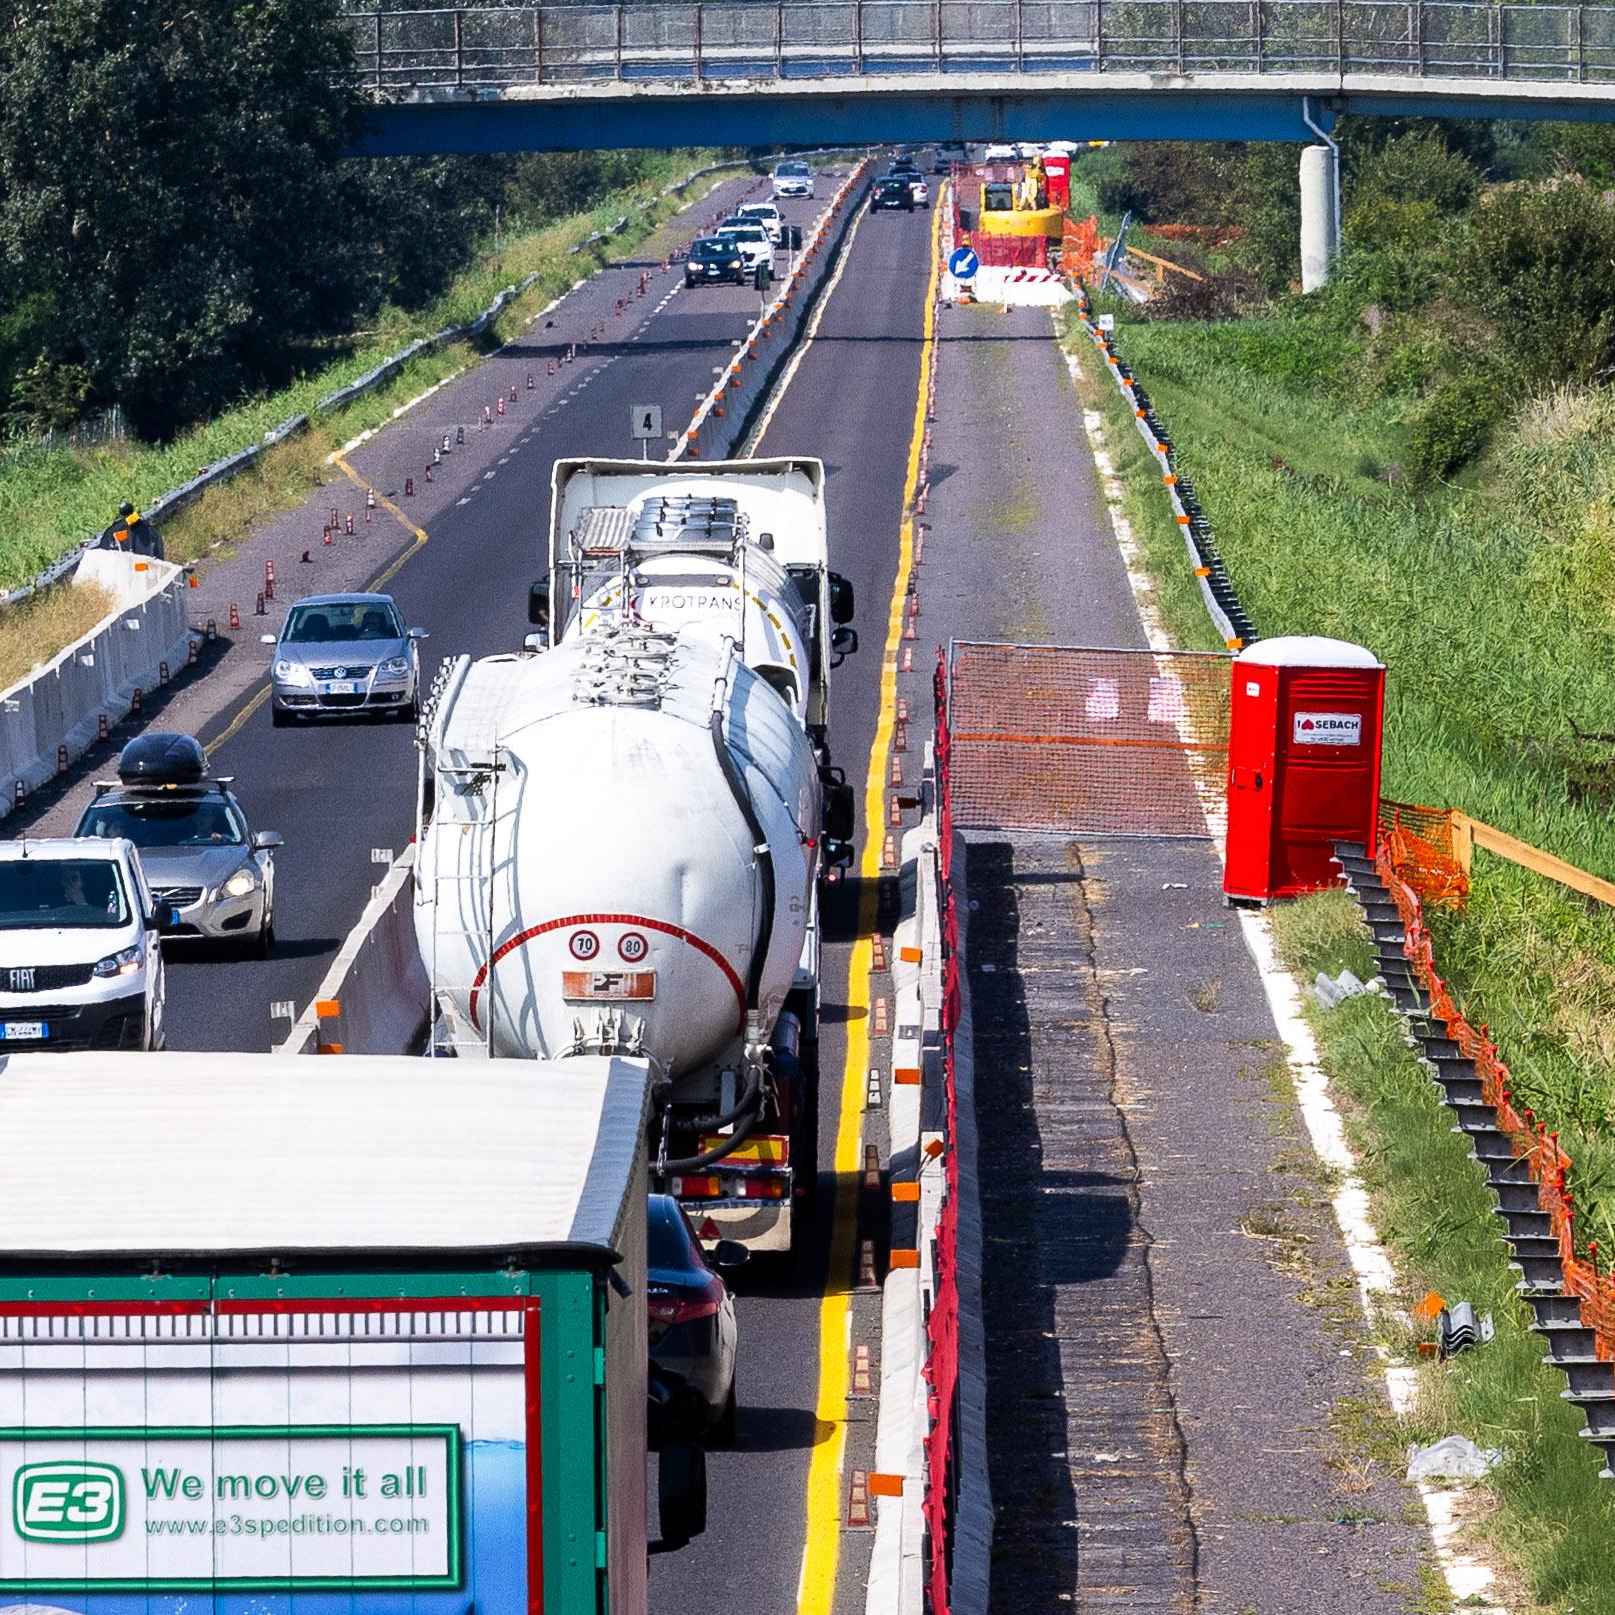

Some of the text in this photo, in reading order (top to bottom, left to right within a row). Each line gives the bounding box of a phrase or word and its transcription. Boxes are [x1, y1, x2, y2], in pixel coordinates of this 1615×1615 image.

[643, 413, 652, 431] 4
[1315, 720, 1359, 729] SEBACH
[578, 938, 593, 951] 70
[625, 940, 641, 953] 80
[9, 968, 35, 989] FIAT
[141, 1466, 426, 1499] We move it all
[25, 1482, 112, 1523] E3
[144, 1515, 429, 1538] www.e3spedition.com
